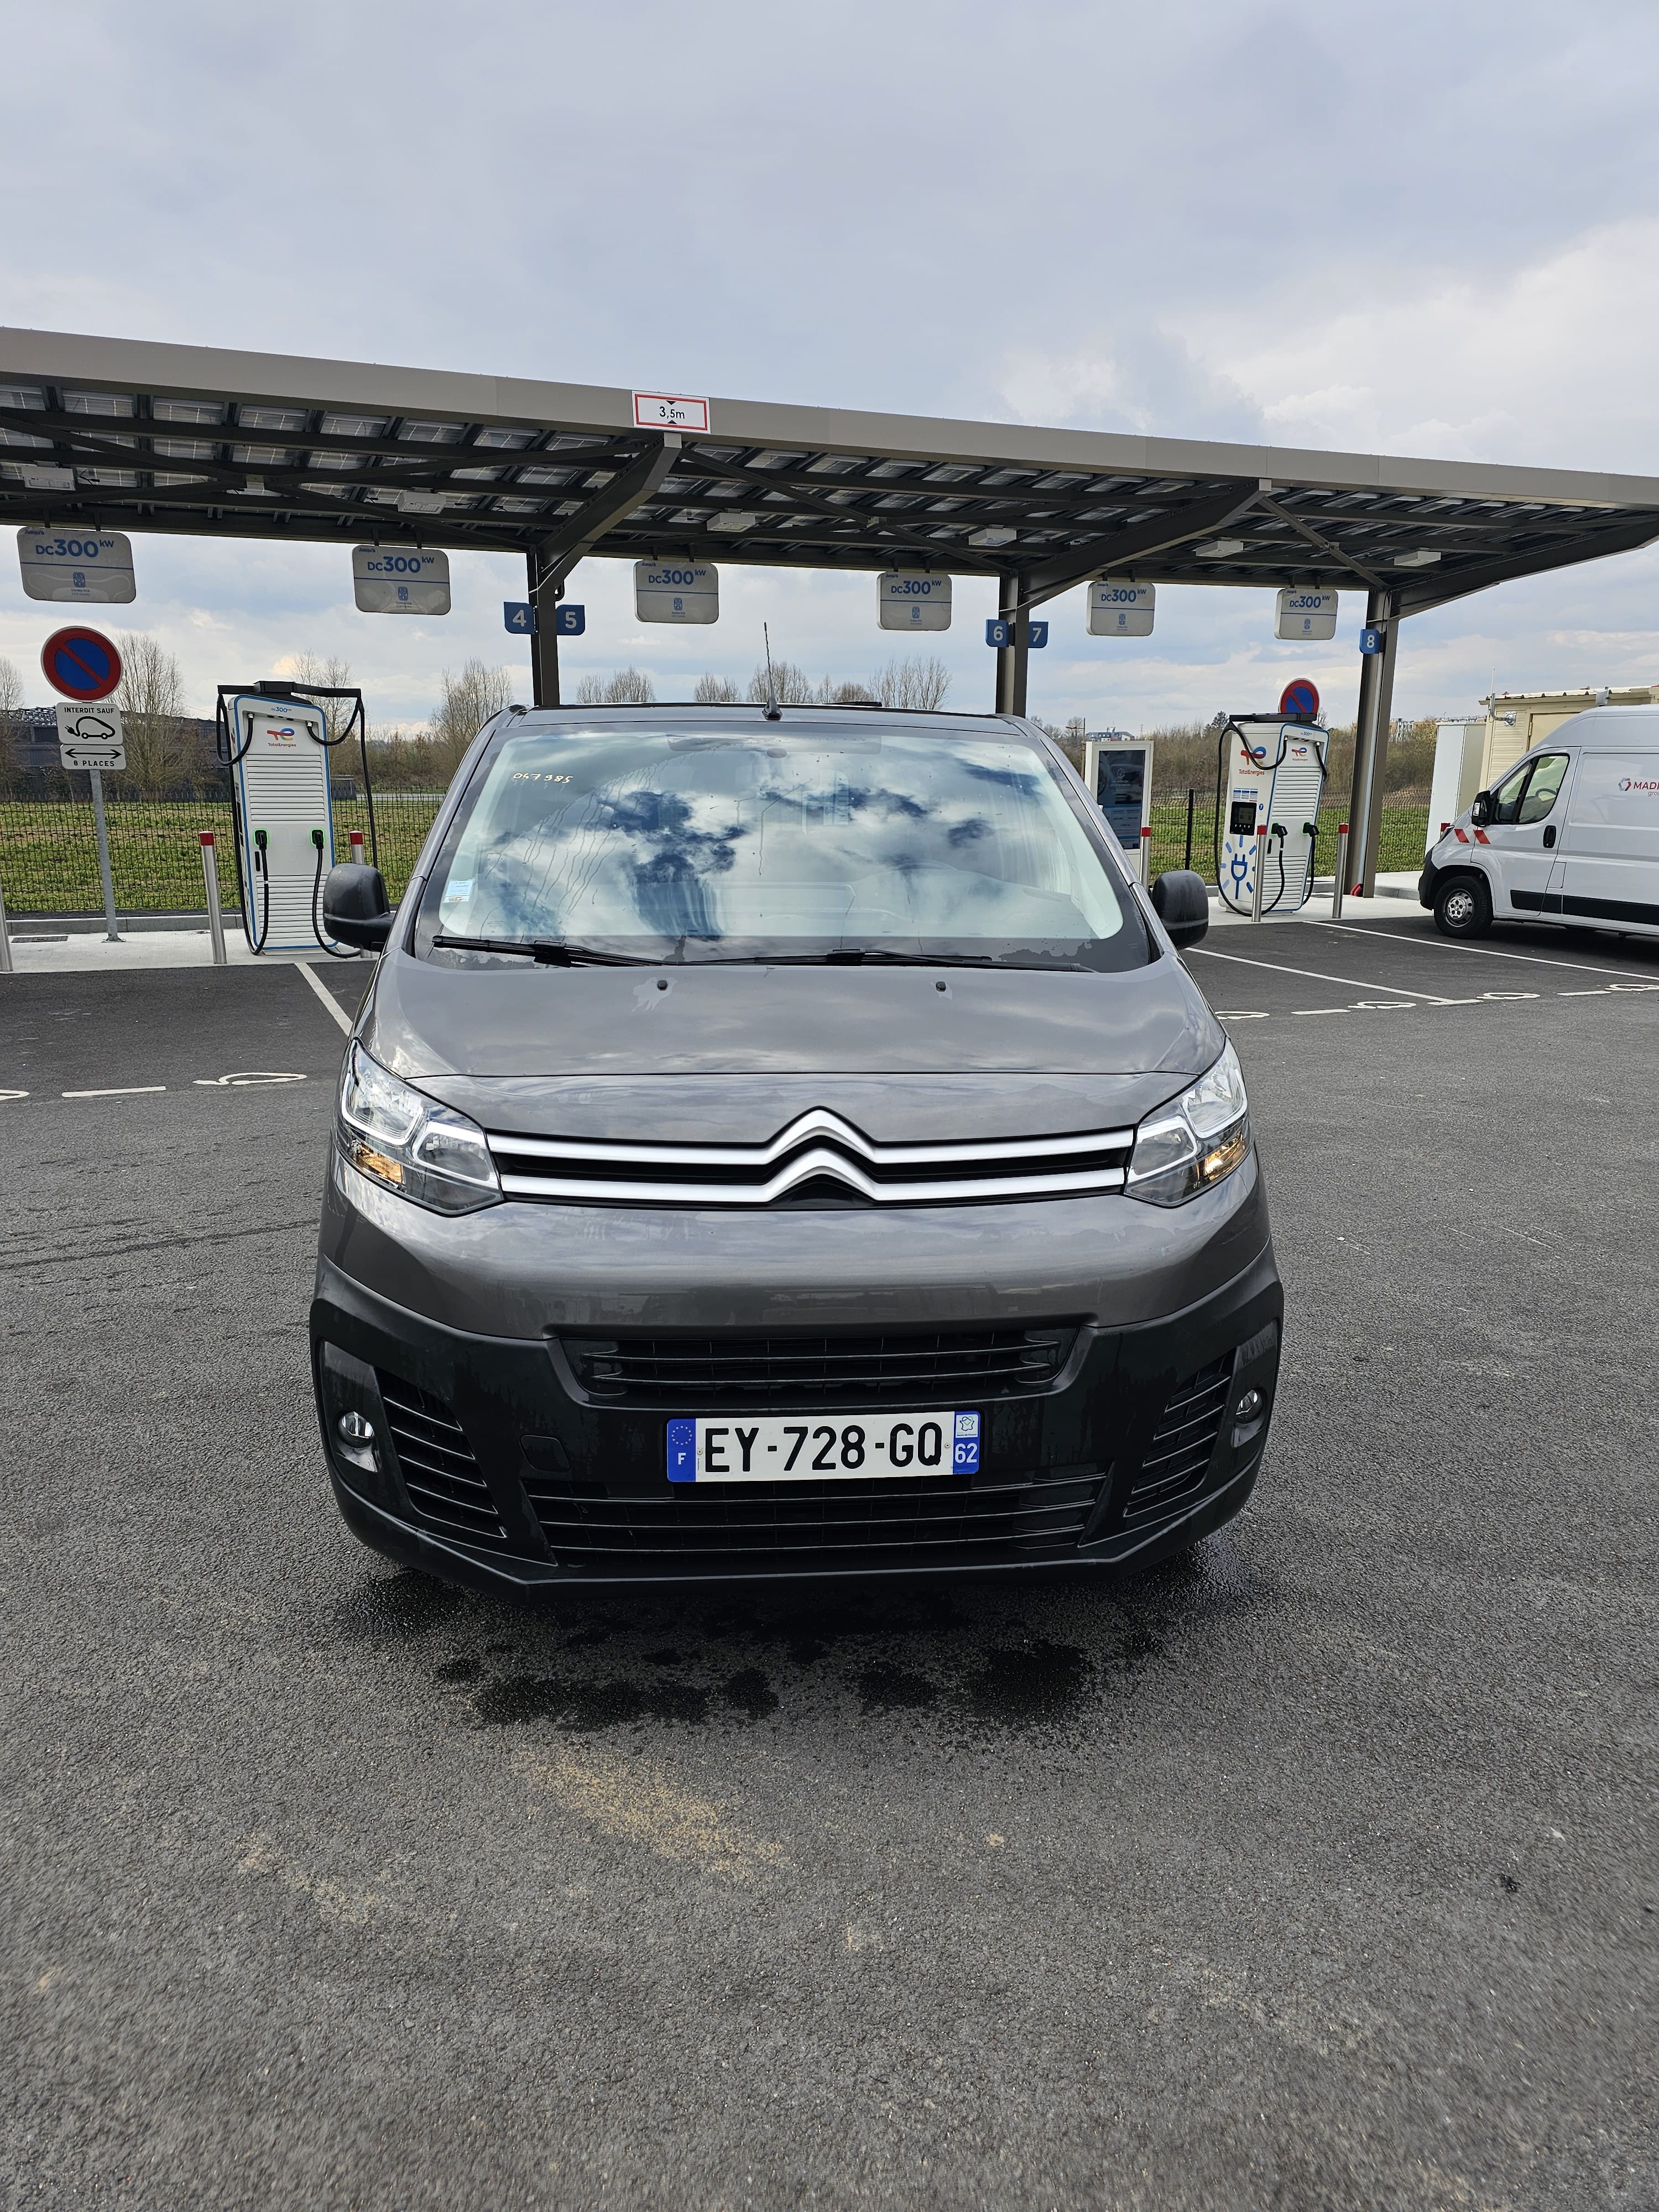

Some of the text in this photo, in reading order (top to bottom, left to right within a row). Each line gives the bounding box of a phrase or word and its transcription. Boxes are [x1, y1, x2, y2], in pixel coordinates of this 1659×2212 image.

[659, 406, 685, 419] 3,5m
[512, 609, 527, 627] 4
[565, 611, 577, 629] 5
[993, 625, 1004, 641] 6
[1032, 627, 1042, 642] 7
[1366, 634, 1375, 649] 8
[677, 1452, 686, 1465] F
[954, 1442, 978, 1464] 62
